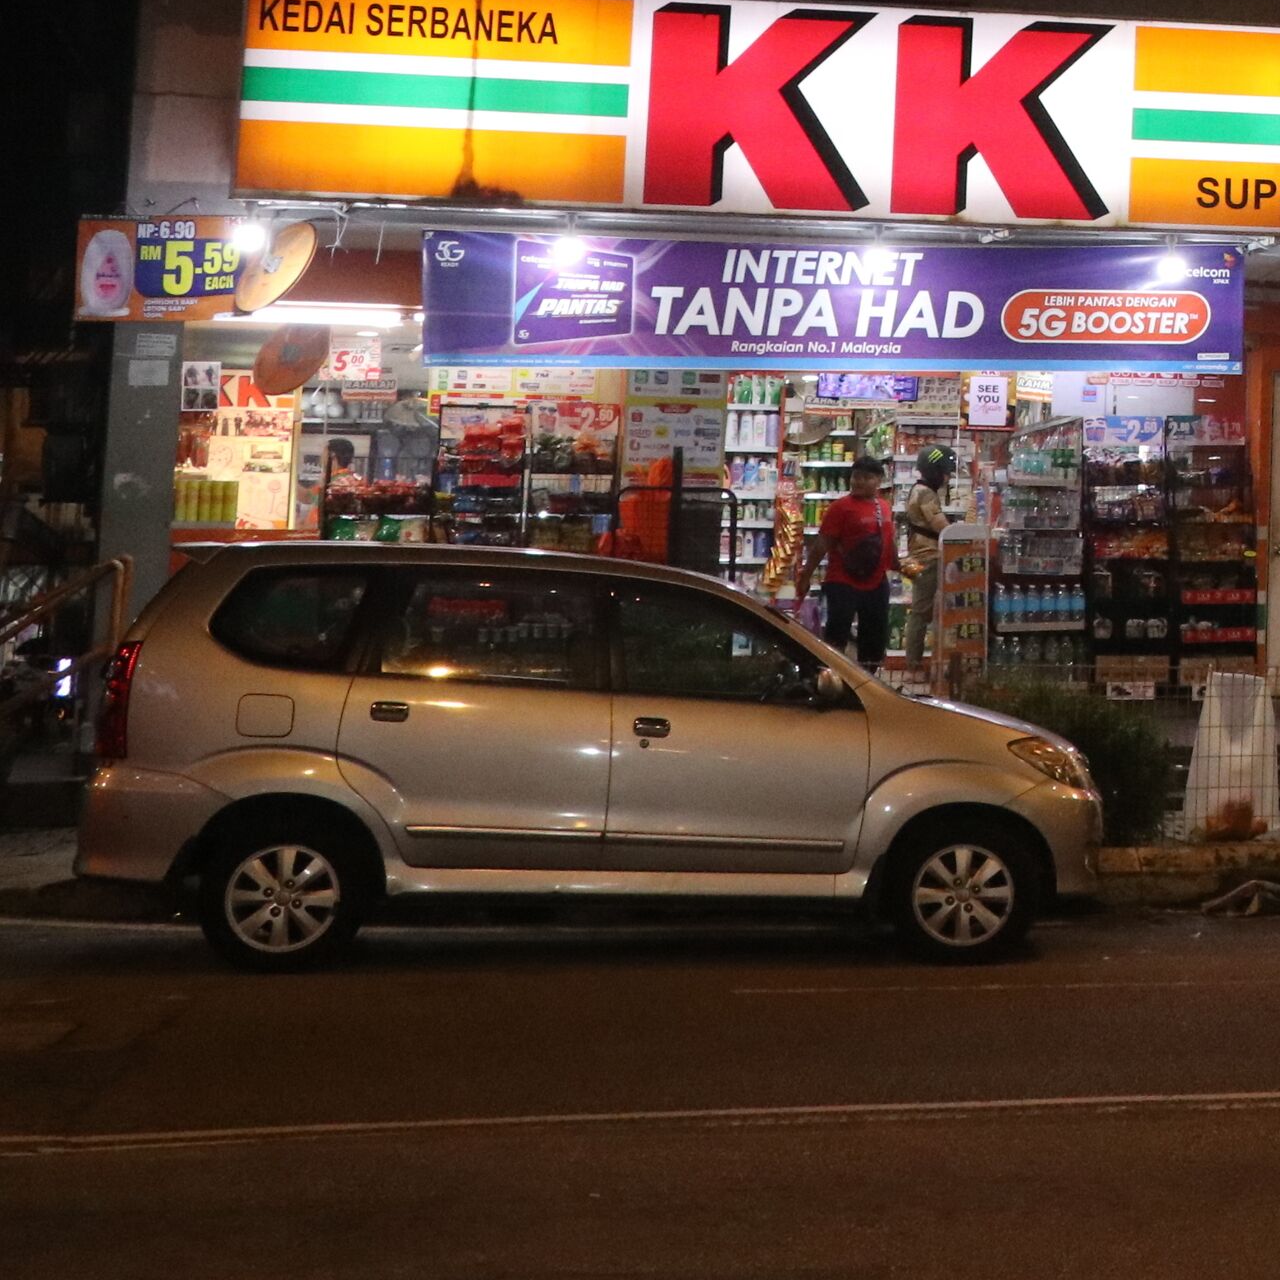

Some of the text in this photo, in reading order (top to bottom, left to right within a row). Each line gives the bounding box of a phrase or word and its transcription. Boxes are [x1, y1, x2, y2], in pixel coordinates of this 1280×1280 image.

[365, 1, 559, 44] SERBANEKA
[643, 0, 1117, 221] KK
[435, 240, 465, 261] 5G
[140, 240, 241, 295] RM 5.59
[722, 248, 924, 287] INTERNET
[1187, 266, 1230, 278] celcom
[205, 275, 234, 290] EACH
[536, 298, 621, 316] PANTAS
[1044, 296, 1177, 308] LEBIH PANTAS DENGAN
[651, 286, 985, 339] TANPA HAD
[1018, 308, 1067, 338] 5G
[731, 340, 901, 357] Rangkaian No.1 Malaysia
[977, 385, 999, 394] SEE
[976, 395, 1000, 404] YOU
